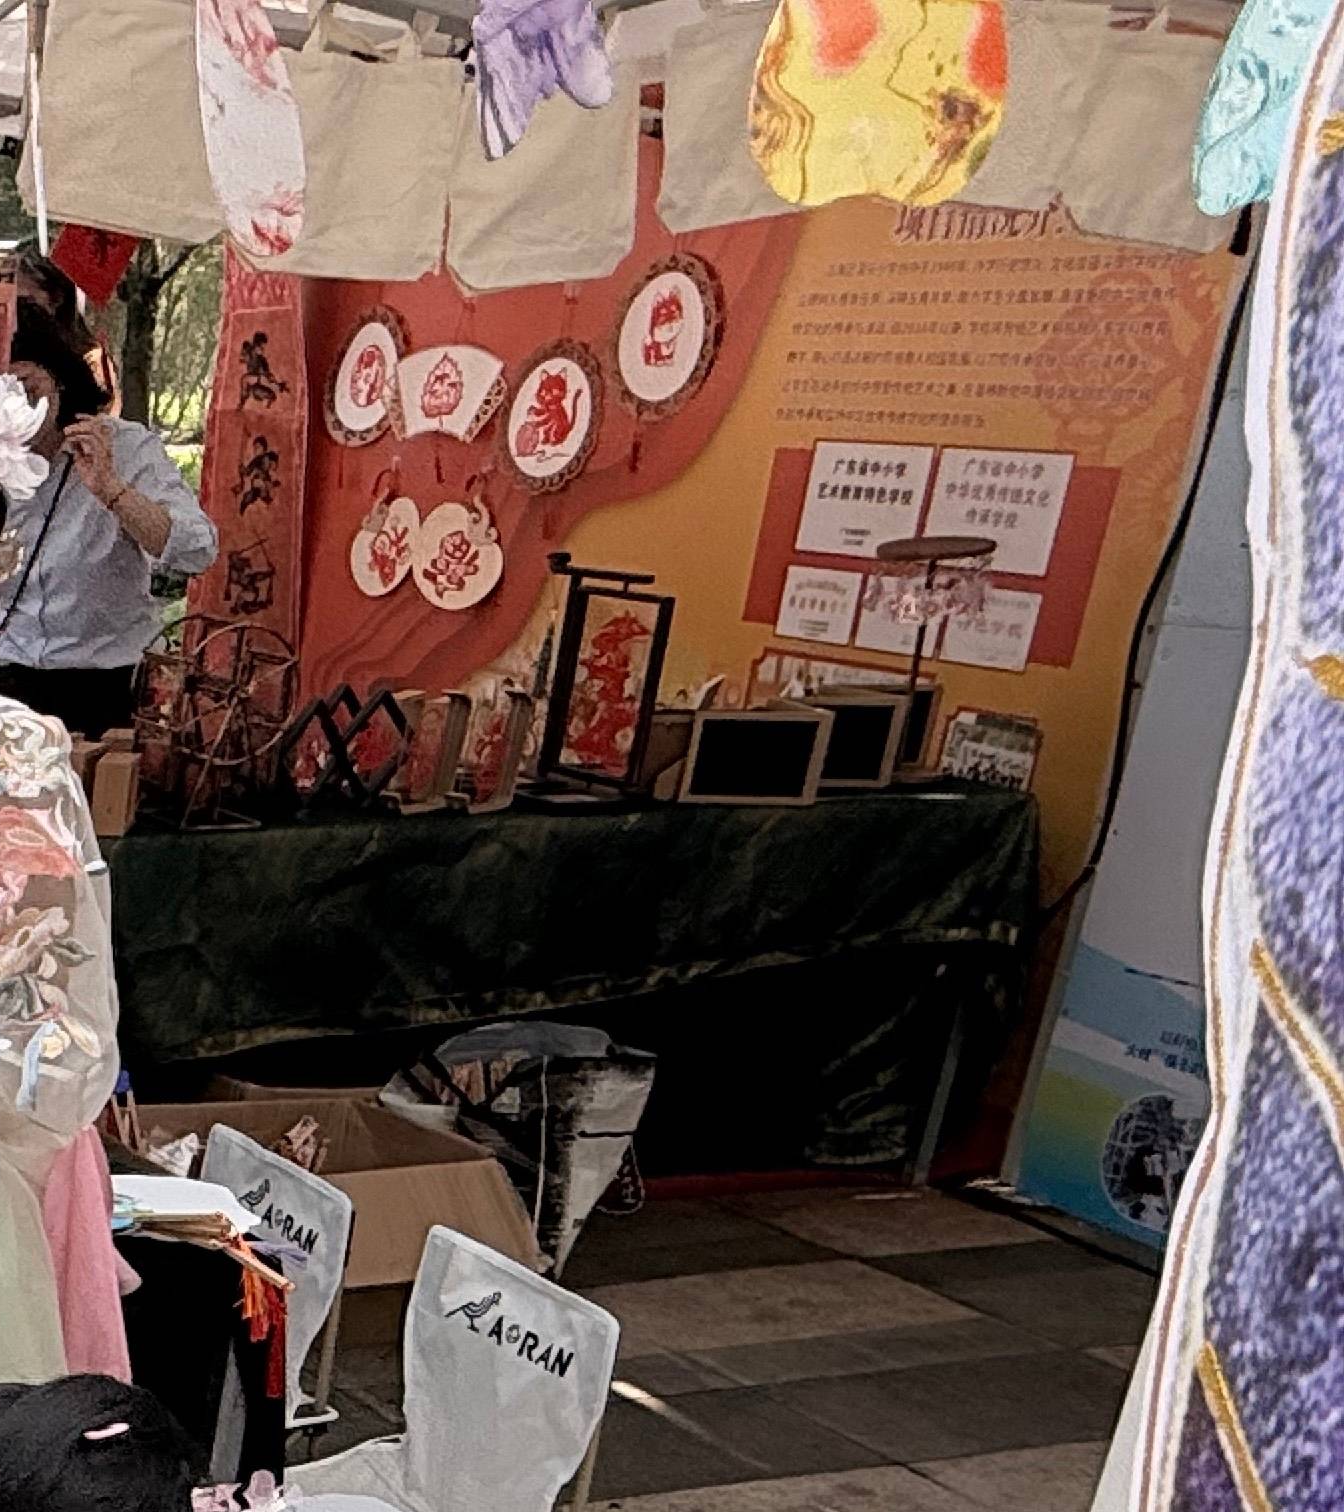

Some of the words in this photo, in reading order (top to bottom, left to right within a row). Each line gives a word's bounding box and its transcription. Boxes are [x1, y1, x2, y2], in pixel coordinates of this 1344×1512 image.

[831, 457, 908, 479] 广东省中小学
[962, 457, 1046, 481] 广东省中小学
[816, 481, 915, 506] 艺术教育特色学校
[944, 480, 1052, 508] 中华优秀传统文化
[488, 1314, 575, 1379] AORAN
